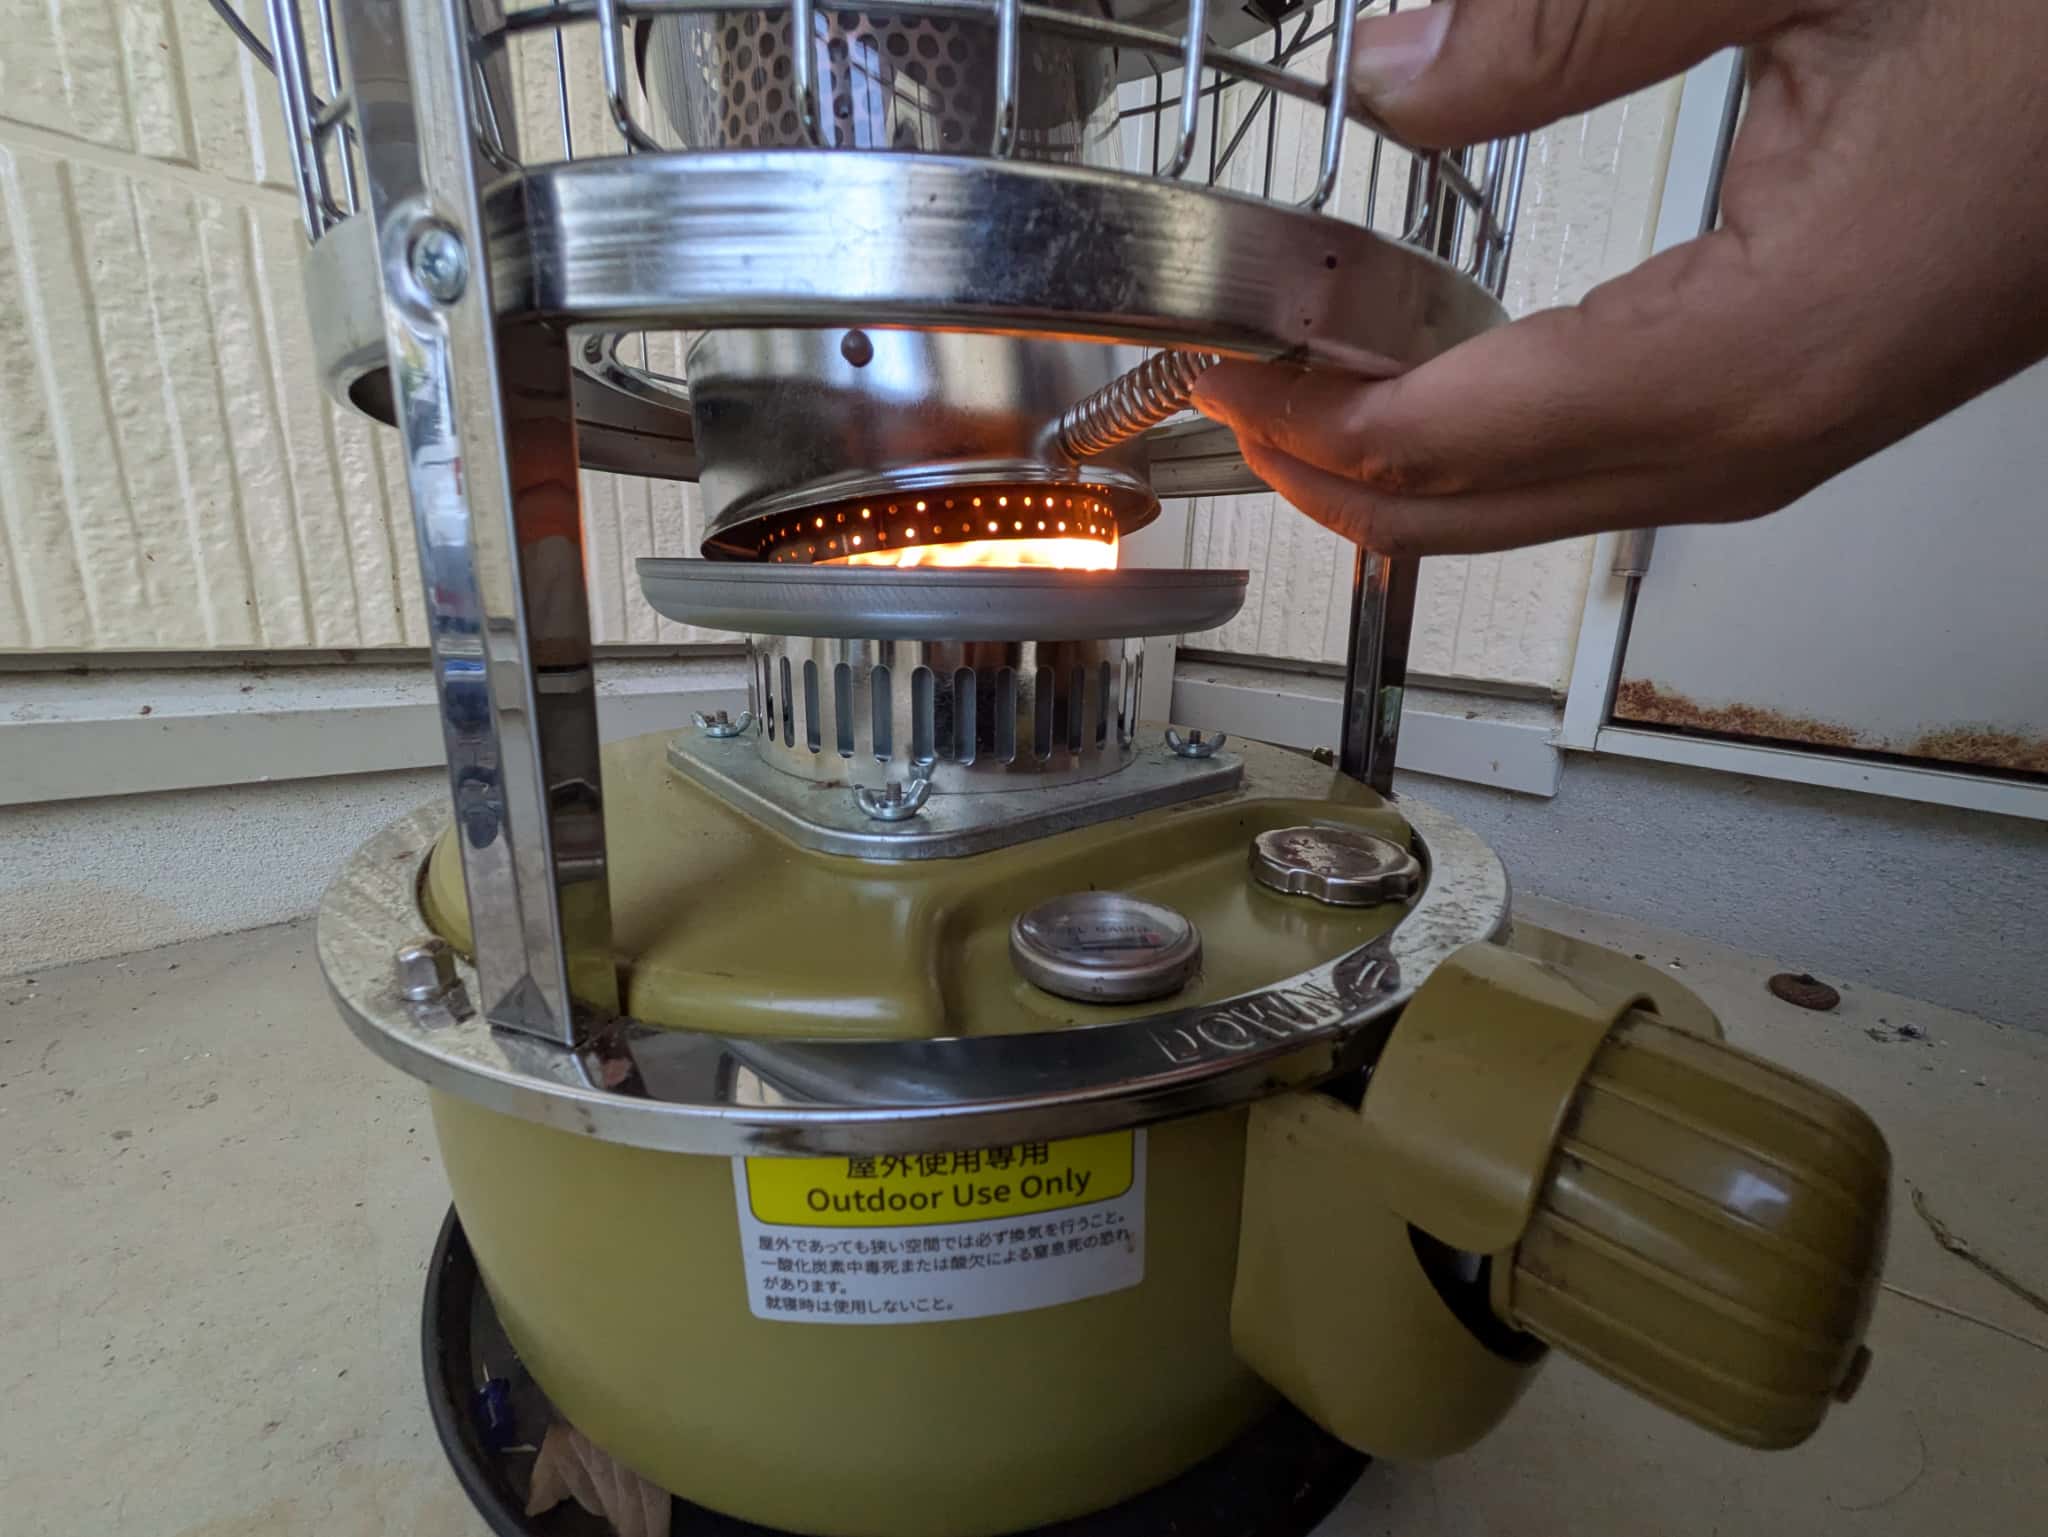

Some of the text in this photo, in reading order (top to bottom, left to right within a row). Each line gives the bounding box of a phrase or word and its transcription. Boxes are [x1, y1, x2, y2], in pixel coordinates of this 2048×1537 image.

[847, 1143, 1050, 1179] 屋外使用専用
[806, 1167, 1092, 1212] Outdoor Use Only
[759, 1211, 1125, 1255] 屋外であっても狭い空間では必ず換気を行うこと。
[763, 1276, 847, 1294] があります。
[765, 1295, 953, 1315] 就寝時は使用しないこと。
